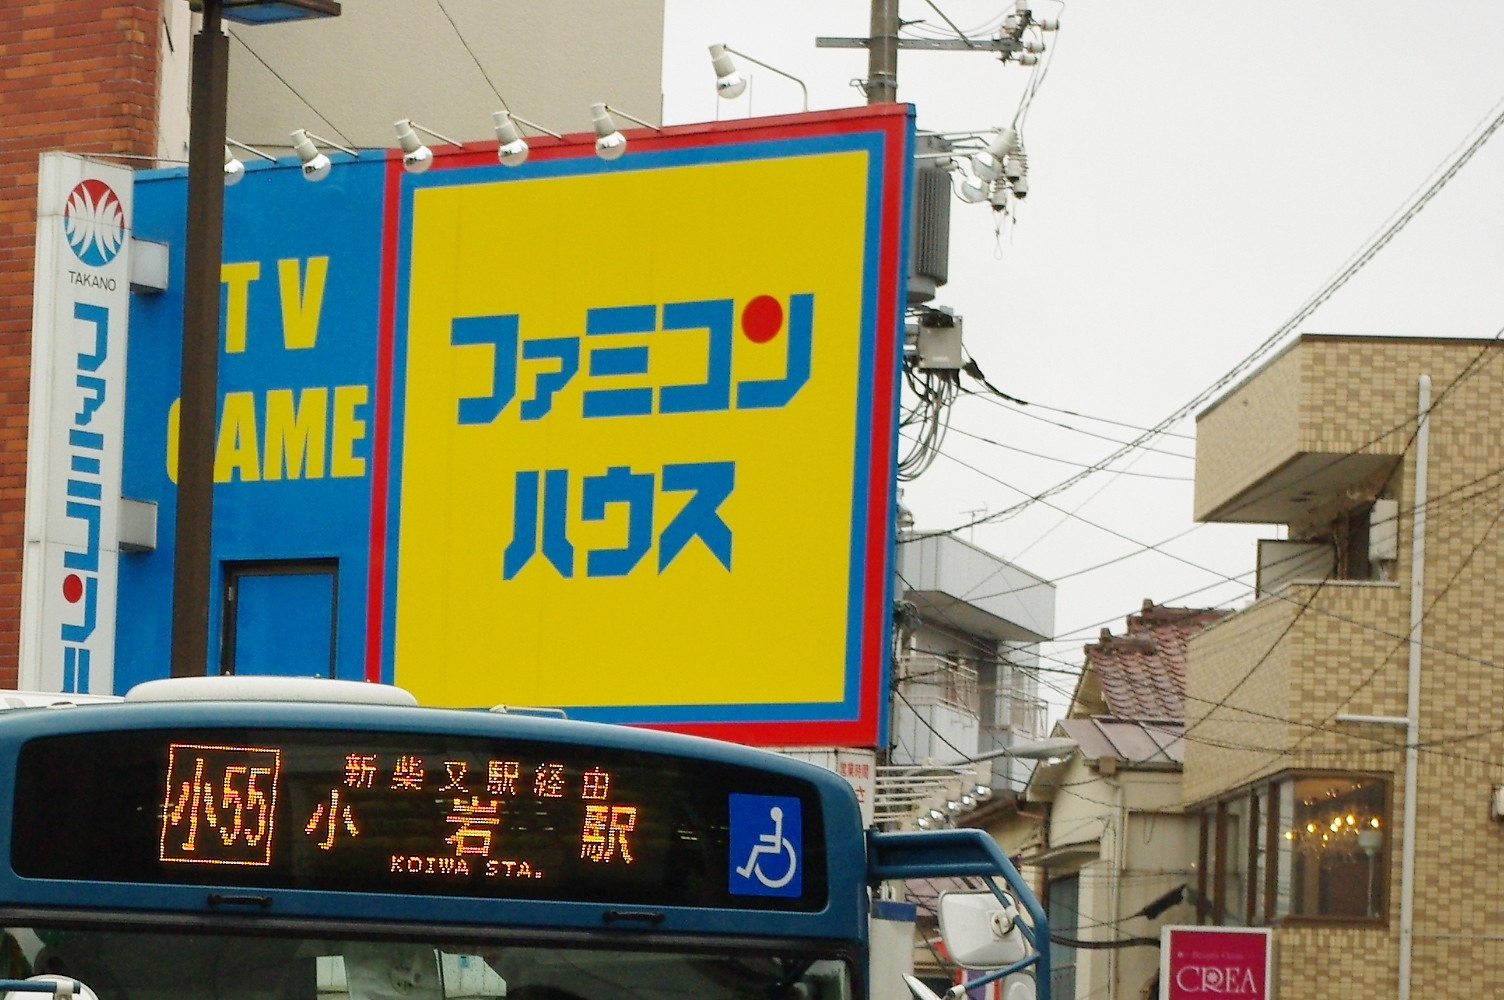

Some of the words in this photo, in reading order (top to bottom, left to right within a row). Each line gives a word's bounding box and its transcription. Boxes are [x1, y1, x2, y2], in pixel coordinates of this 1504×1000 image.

[68, 269, 117, 293] TAKANO
[450, 293, 815, 425] ファミコン
[167, 385, 369, 486] AME
[502, 460, 736, 581] ハウス
[169, 757, 272, 851] 小55
[344, 753, 610, 800] 新柴又駅経由
[390, 855, 470, 877] KOIWA
[485, 859, 543, 880] STA.
[1176, 965, 1258, 994] CREA
